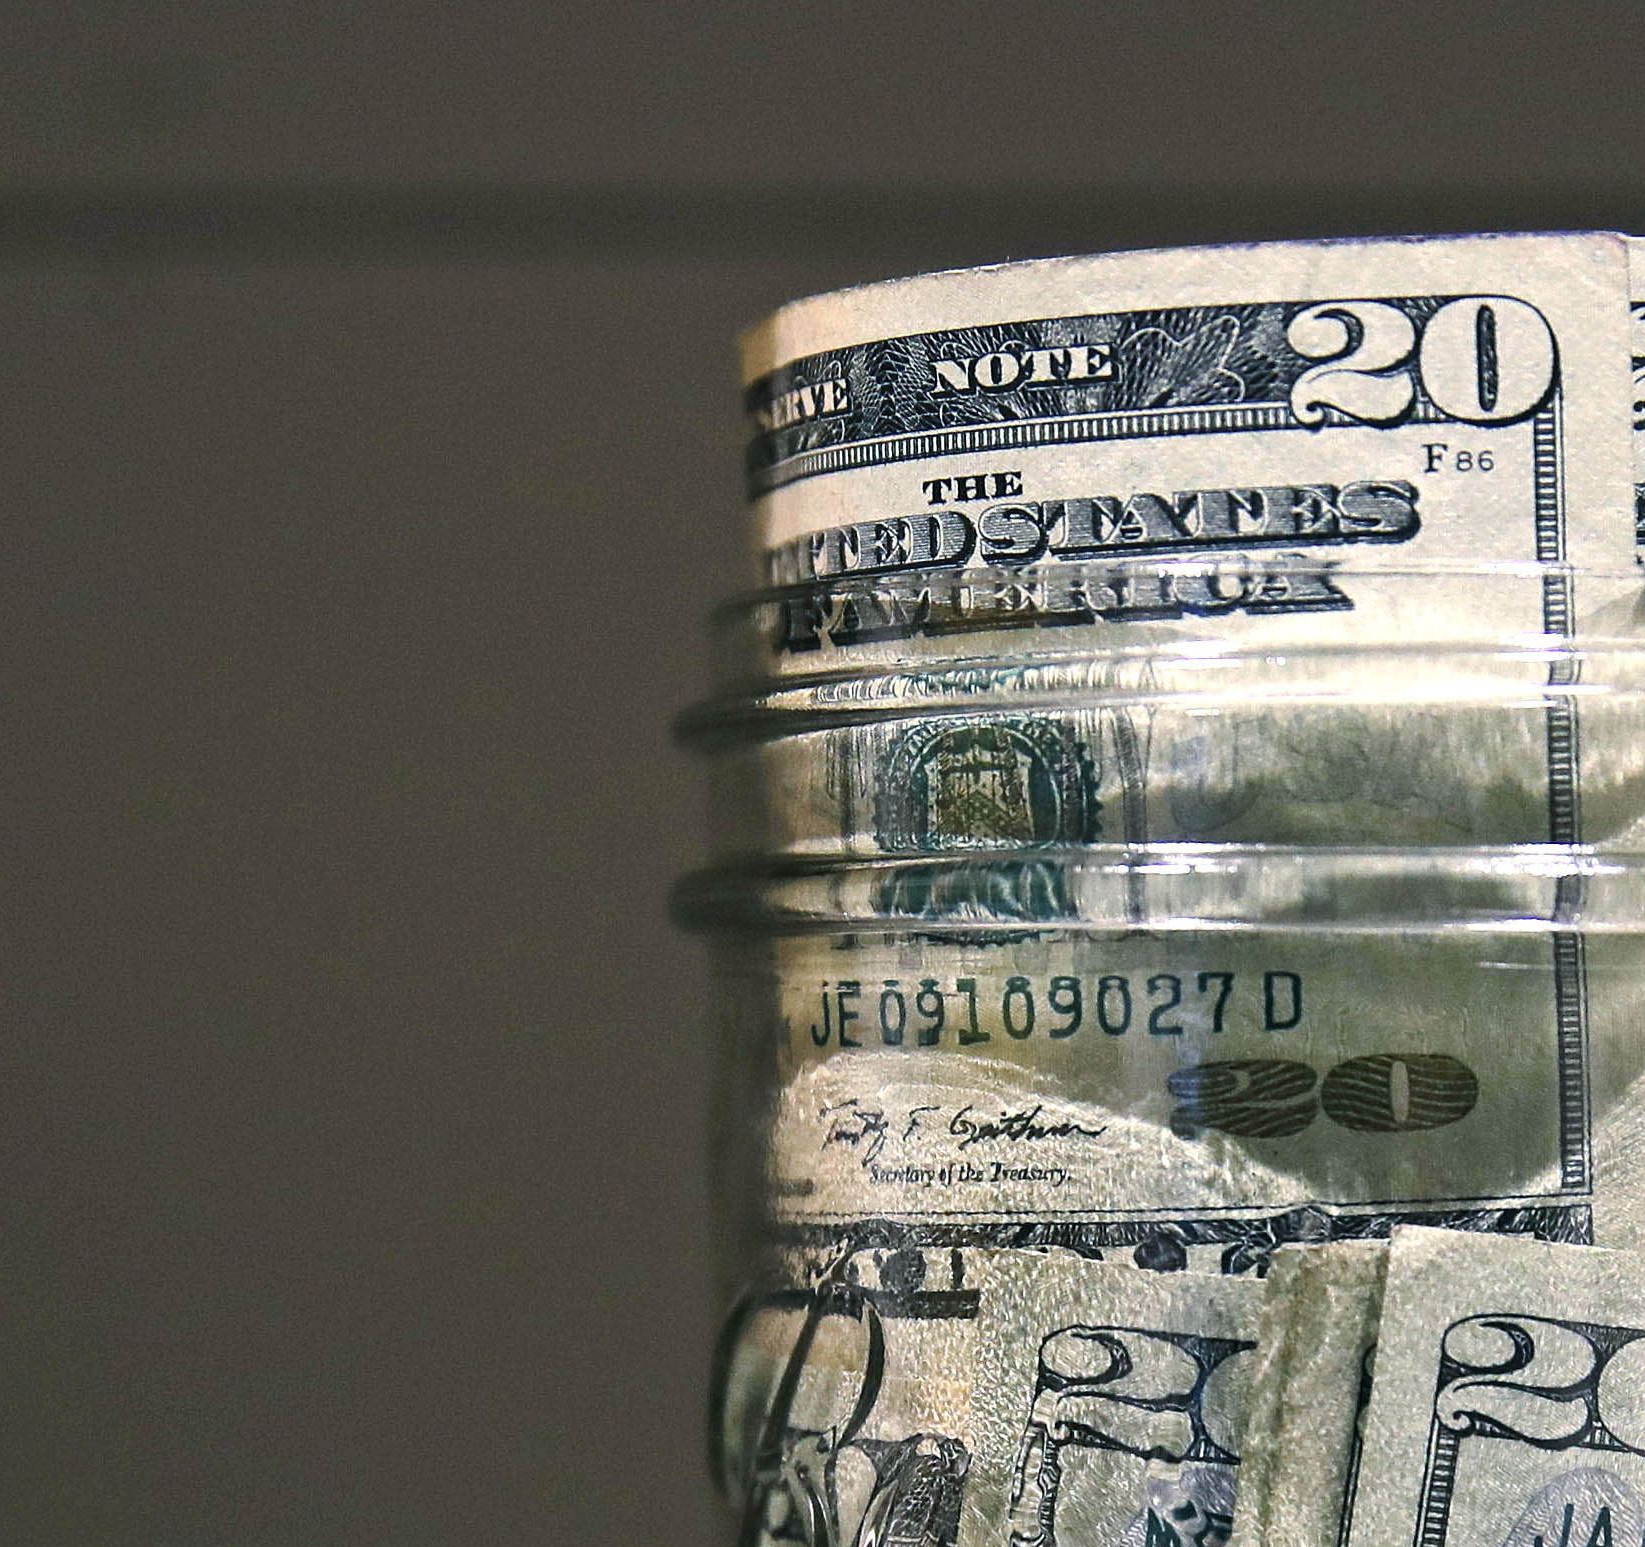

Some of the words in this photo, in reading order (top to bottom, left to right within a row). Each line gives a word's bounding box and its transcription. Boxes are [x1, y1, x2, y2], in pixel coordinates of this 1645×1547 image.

[932, 342, 1117, 404] NOTE
[1286, 295, 1564, 431] 20
[922, 471, 1024, 505] THE
[976, 478, 1421, 565] STATES
[1167, 1053, 1480, 1140] 20
[869, 1164, 935, 1184] Secretary
[938, 1161, 956, 1187] of
[957, 1162, 984, 1183] the
